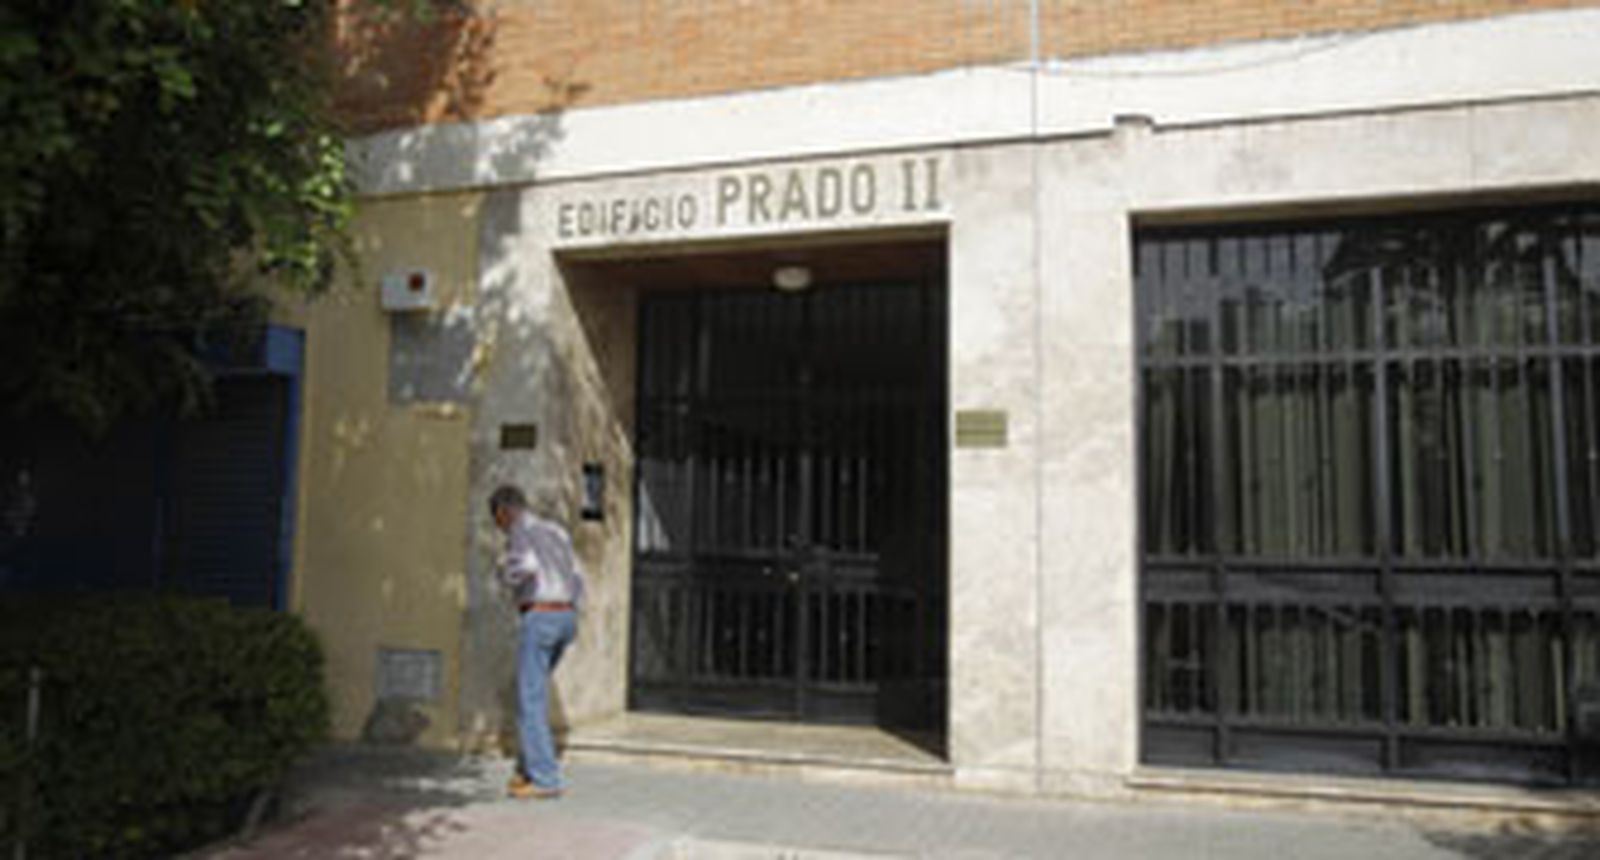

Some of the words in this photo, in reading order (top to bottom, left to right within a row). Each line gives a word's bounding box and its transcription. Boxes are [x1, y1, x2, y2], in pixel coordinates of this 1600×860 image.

[558, 194, 697, 238] EDIFICIO
[716, 163, 876, 227] PRADO
[901, 157, 941, 211] II
